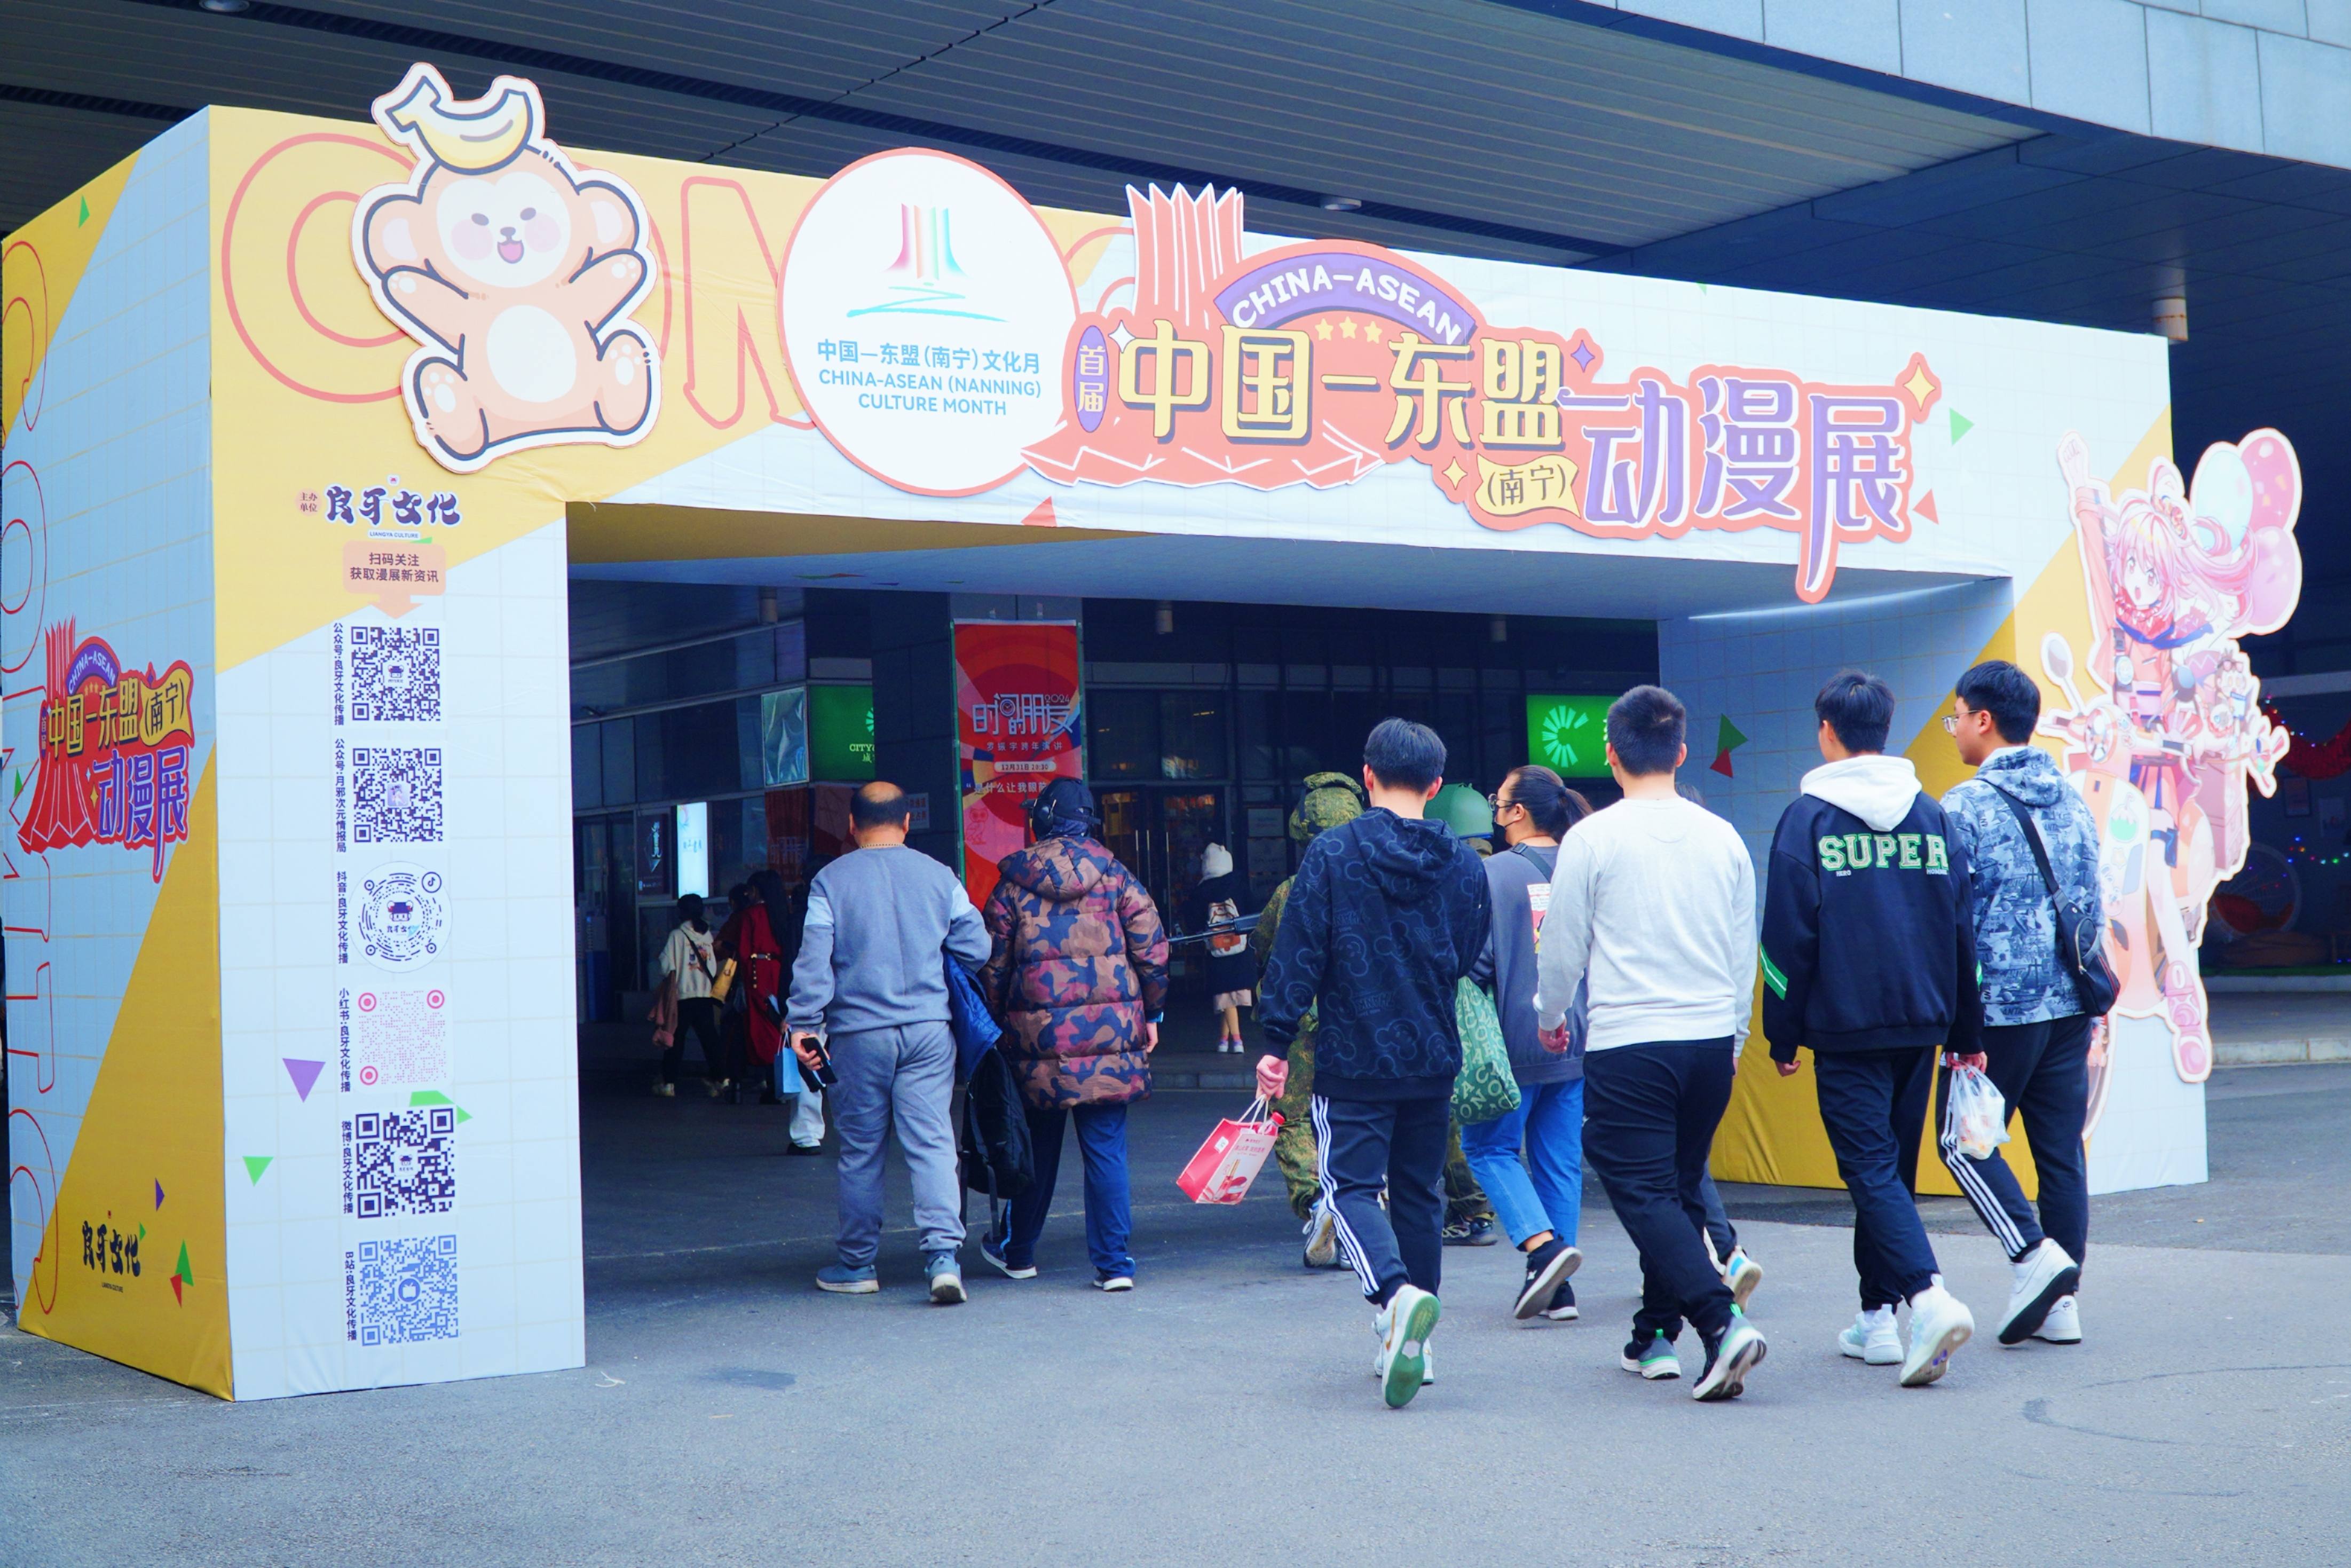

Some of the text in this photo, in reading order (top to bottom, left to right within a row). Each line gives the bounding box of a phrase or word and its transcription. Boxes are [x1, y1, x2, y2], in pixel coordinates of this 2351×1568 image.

[1232, 265, 1462, 345] CHINA-ASEAN
[819, 369, 1041, 398] CHINA-ASEAN (NANNING)
[1078, 345, 1106, 412] 首届
[858, 393, 1007, 415] CULTURE MONTH
[300, 492, 318, 502] 主办
[1556, 376, 1906, 592] 动漫展
[300, 502, 318, 513] 单位
[327, 486, 460, 525] 良牙文化
[350, 567, 439, 582] 获取漫展新资讯
[369, 552, 420, 566] 扫码关注
[68, 650, 115, 695] CHINA-ASEAN
[1045, 694, 1070, 703] 2024
[92, 745, 187, 876] 动漫展
[1818, 833, 1949, 871] SUPER
